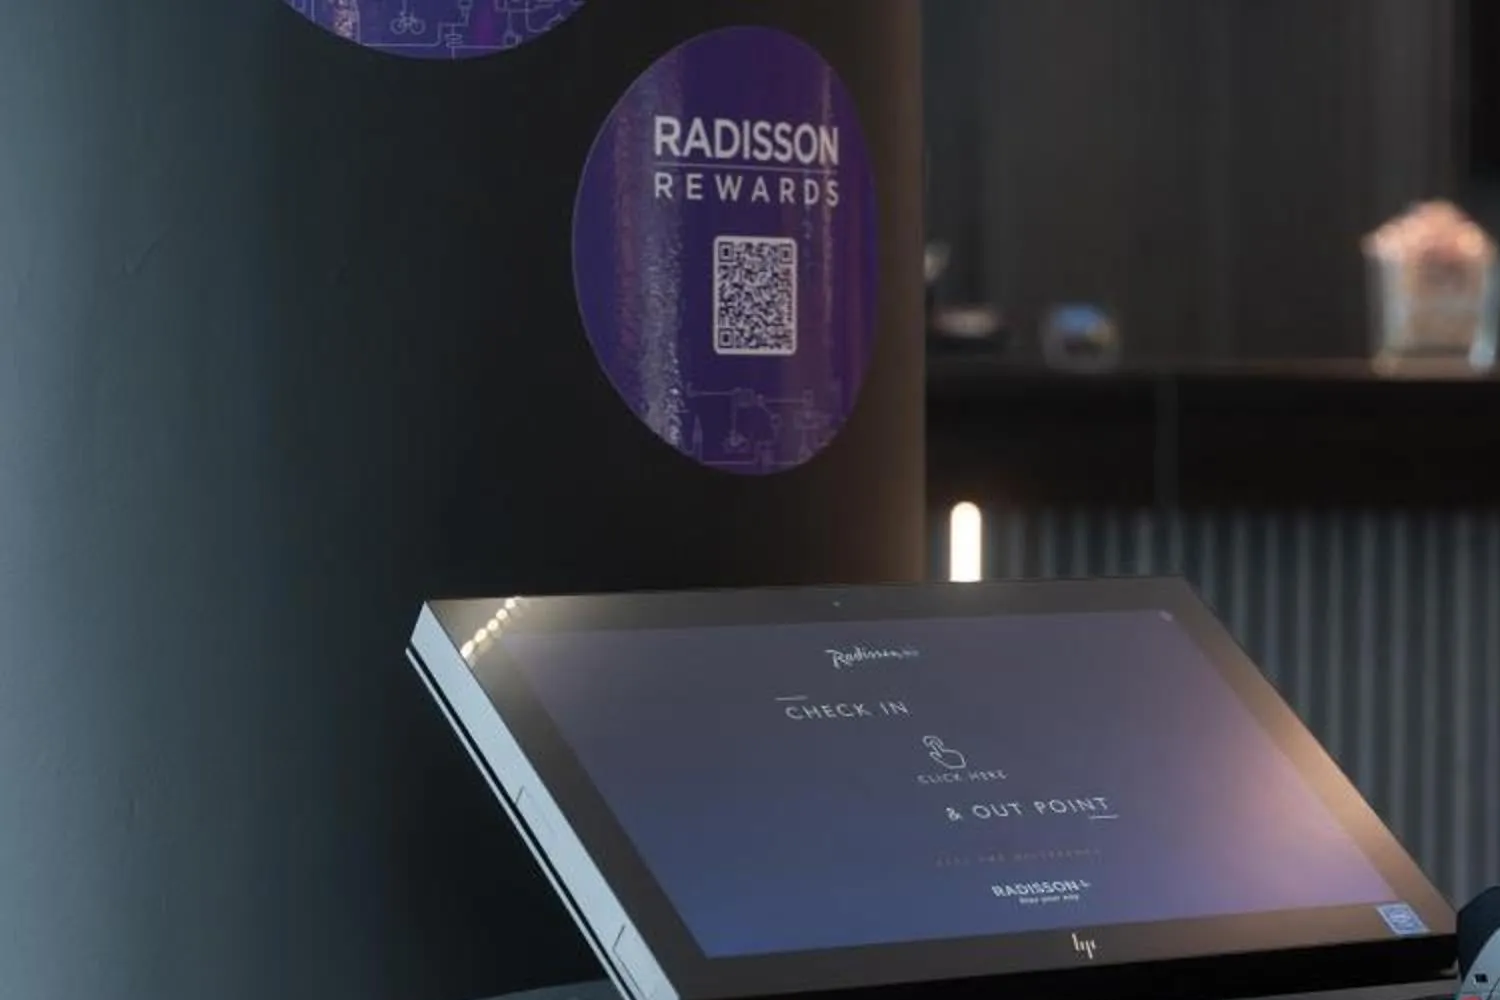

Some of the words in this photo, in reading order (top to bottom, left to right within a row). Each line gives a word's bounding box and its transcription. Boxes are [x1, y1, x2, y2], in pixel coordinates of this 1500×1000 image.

[654, 115, 839, 165] RADISSON
[654, 171, 840, 206] REWARDS
[785, 703, 873, 720] CHECK
[880, 700, 911, 717] IN
[917, 773, 962, 785] CLICK
[945, 807, 962, 821] &
[971, 803, 1022, 820] OUT
[1032, 797, 1106, 816] POINT
